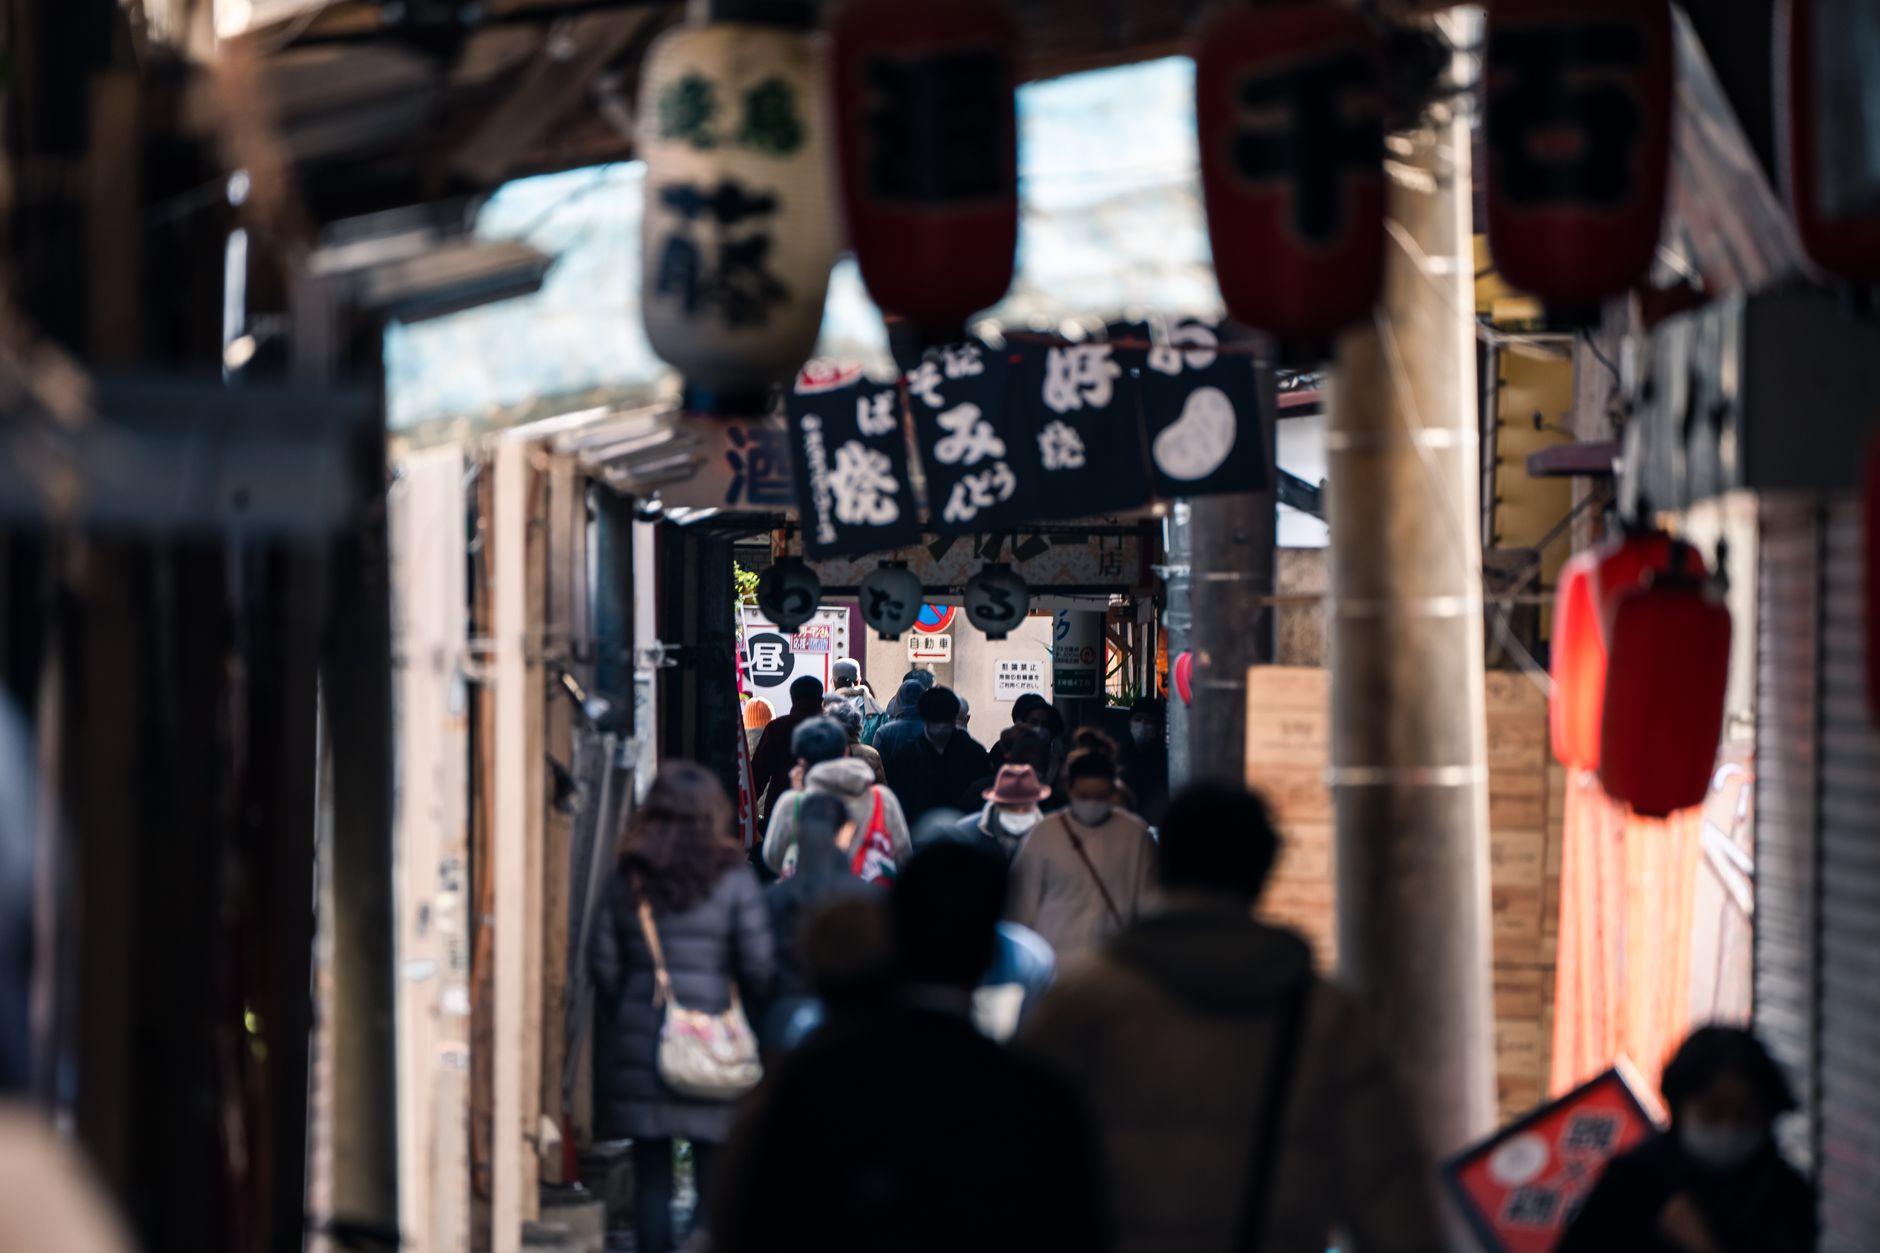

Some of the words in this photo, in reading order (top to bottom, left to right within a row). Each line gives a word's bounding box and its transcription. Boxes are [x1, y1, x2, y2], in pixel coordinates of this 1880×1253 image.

[909, 637, 950, 651] 自動車
[750, 643, 785, 677] 昼
[1001, 663, 1037, 671] 駐輪禁止
